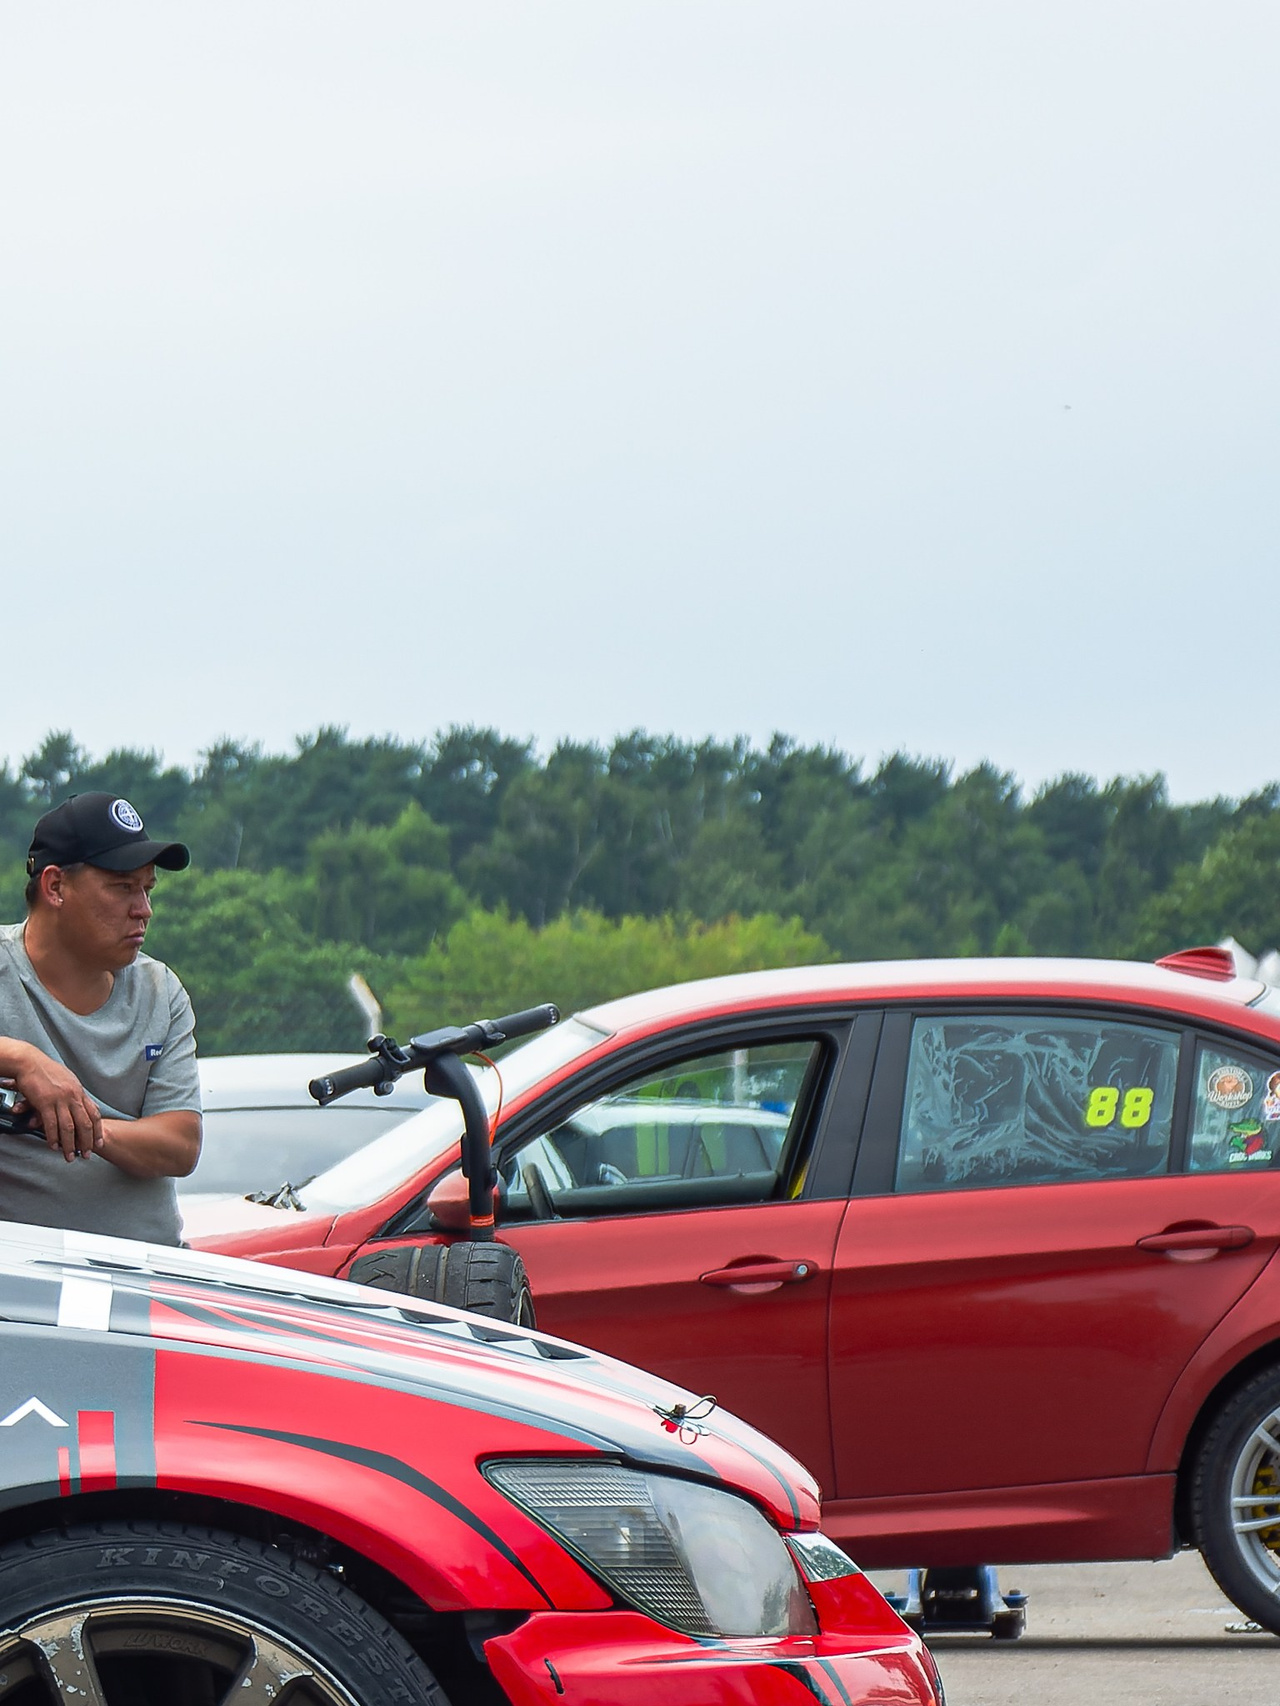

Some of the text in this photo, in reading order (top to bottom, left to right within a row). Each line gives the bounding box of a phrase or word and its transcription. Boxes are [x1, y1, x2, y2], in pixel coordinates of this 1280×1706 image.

[1086, 1087, 1154, 1127] 88
[97, 1549, 416, 1704] KINFOREST
[148, 1635, 208, 1658] WORK
